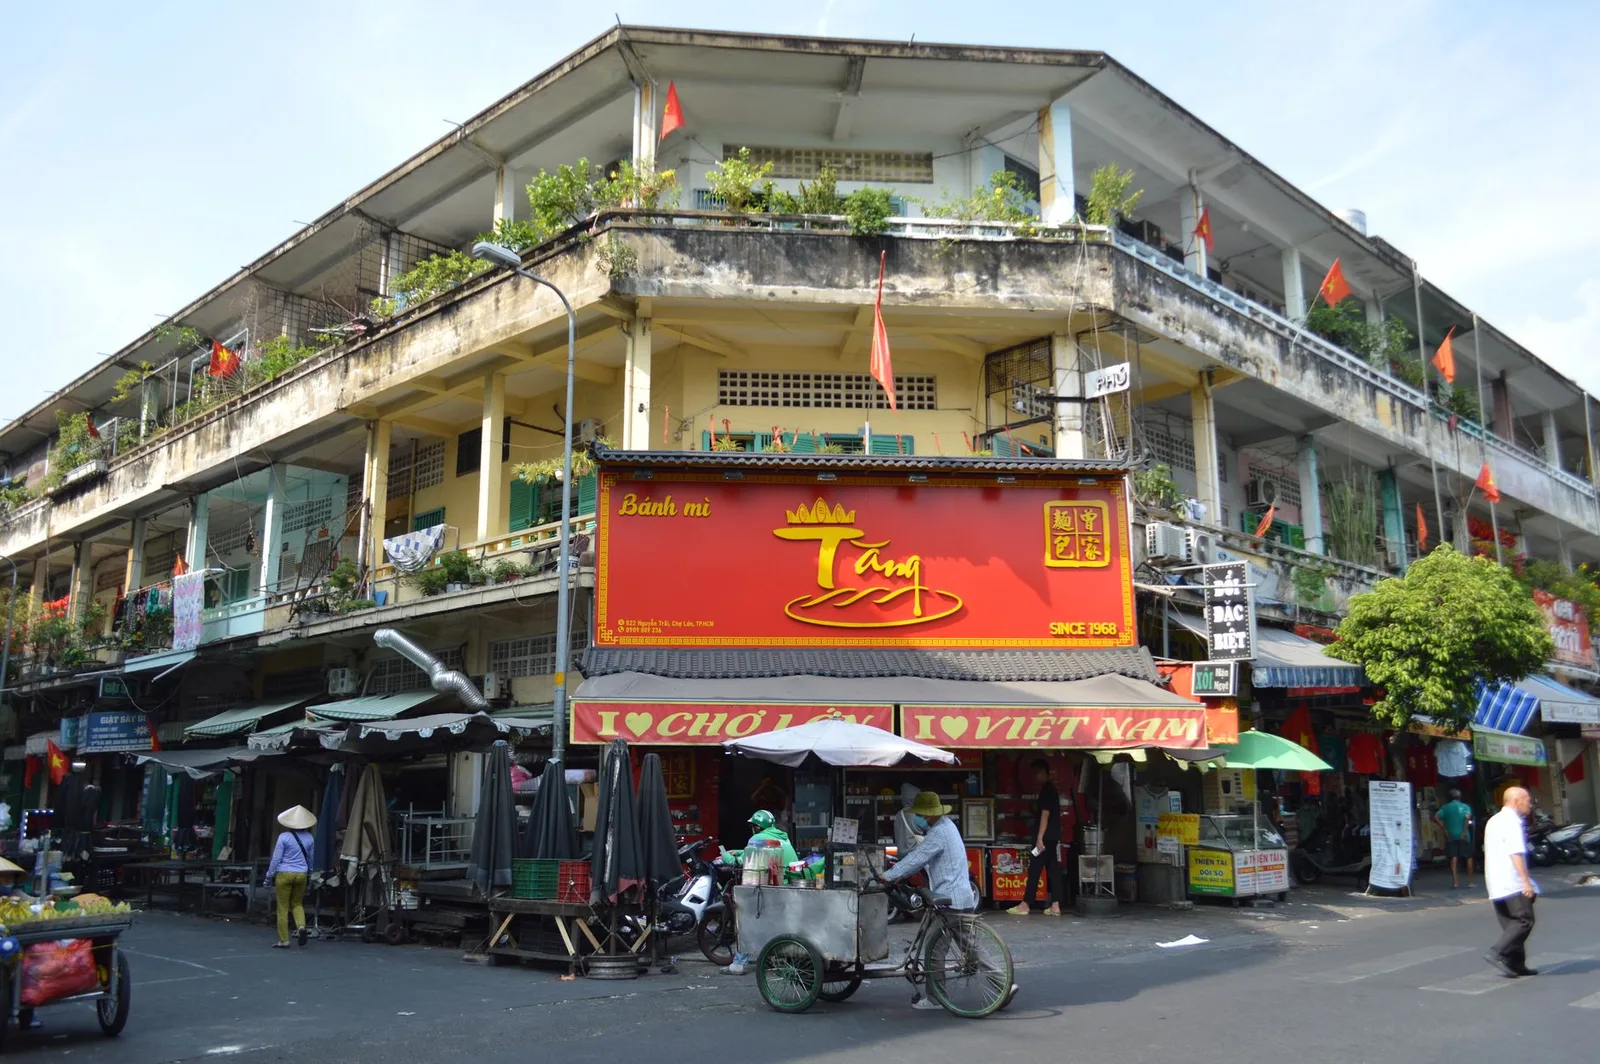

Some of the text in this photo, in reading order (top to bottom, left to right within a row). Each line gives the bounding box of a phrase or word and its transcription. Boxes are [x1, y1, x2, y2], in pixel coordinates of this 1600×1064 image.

[1096, 366, 1128, 391] PHÚ
[618, 493, 711, 517] Bánh mì
[772, 526, 922, 617] Tăng
[1212, 600, 1244, 627] ĐẶC
[1049, 621, 1117, 635] SINCE 1968
[1213, 627, 1247, 654] BIỆT
[1195, 666, 1214, 690] XÔI
[597, 711, 620, 737] I
[656, 709, 767, 737] CHỢ
[914, 714, 936, 740] I
[974, 709, 1090, 747] VIỆT
[1096, 716, 1200, 741] NAM
